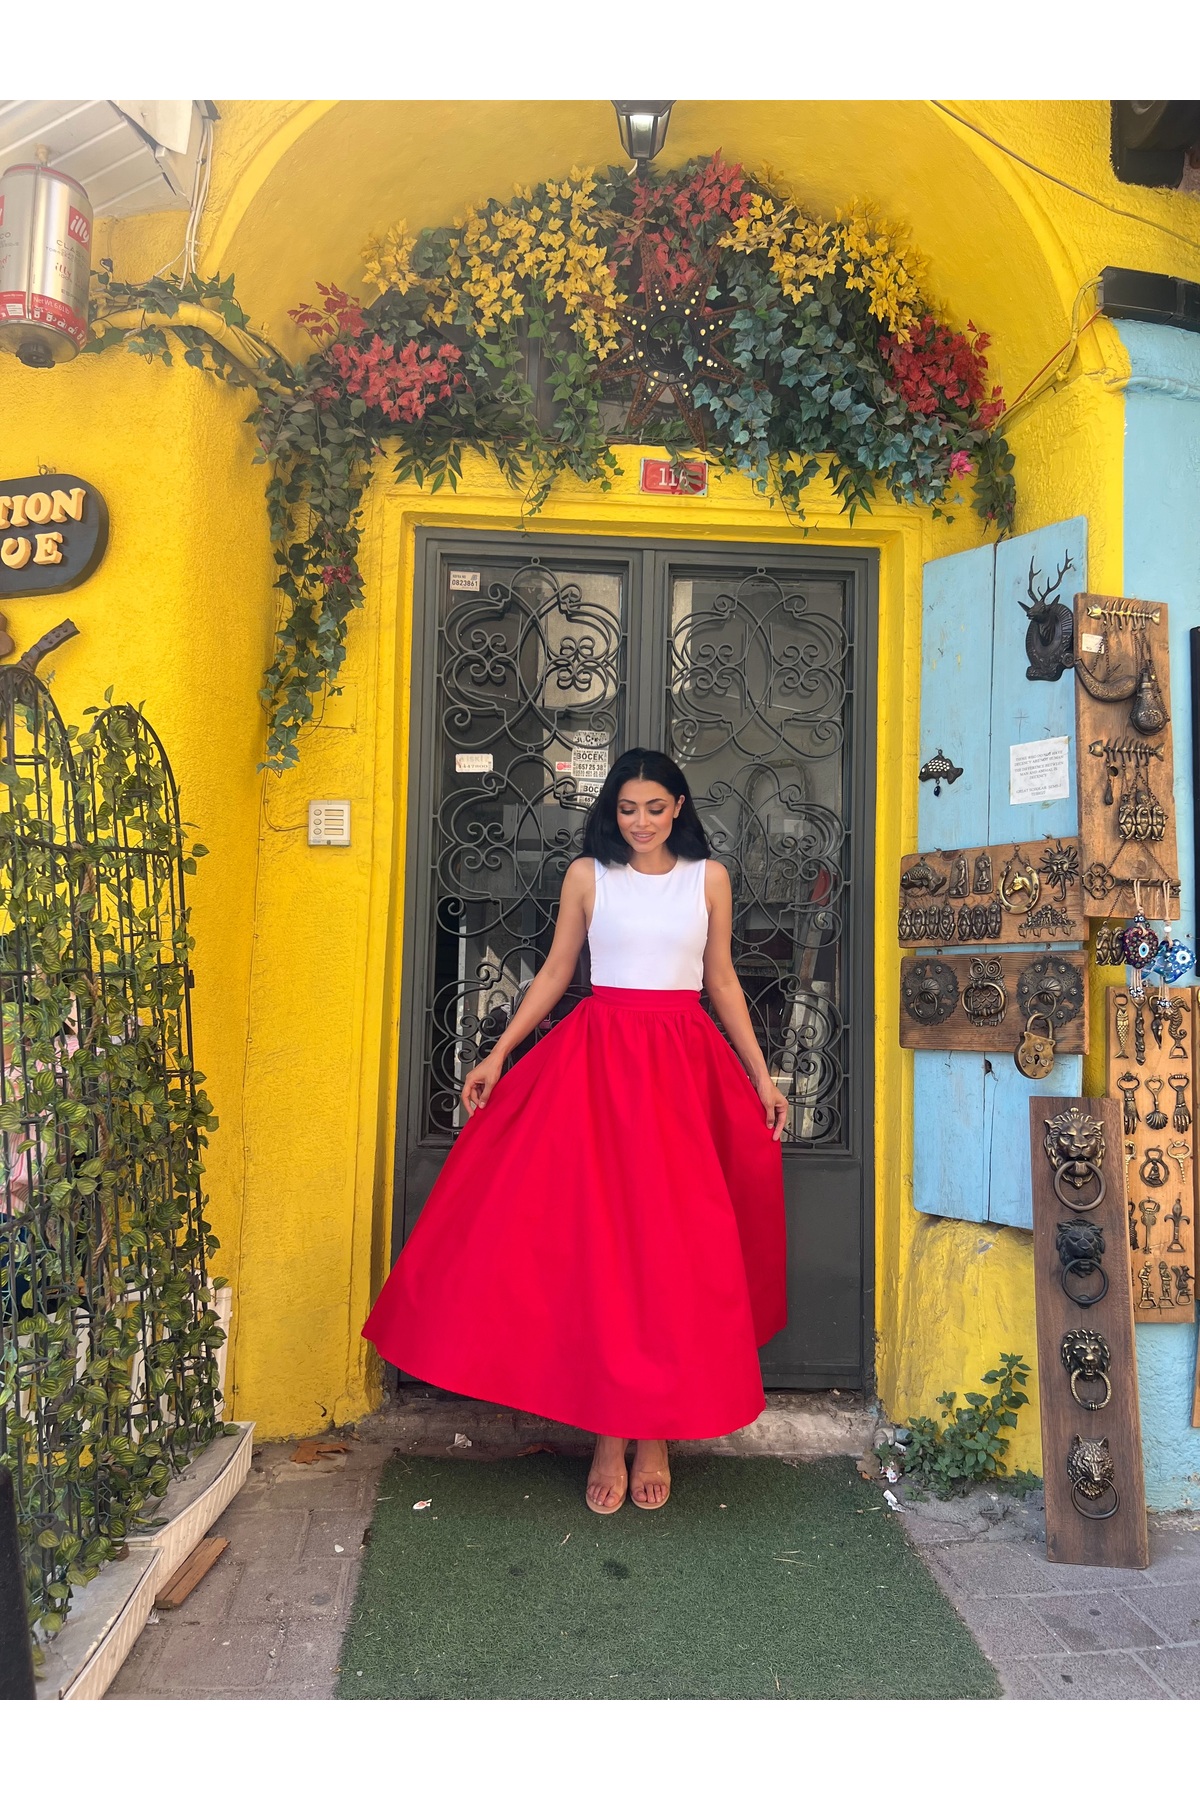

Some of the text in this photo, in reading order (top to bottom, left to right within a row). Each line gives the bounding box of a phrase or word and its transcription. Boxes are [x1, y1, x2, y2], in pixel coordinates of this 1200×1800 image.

[69, 215, 90, 243] illy
[33, 296, 44, 304] Net
[0, 487, 86, 530] TION
[1, 531, 64, 570] UE
[576, 751, 604, 761] BÖCEK
